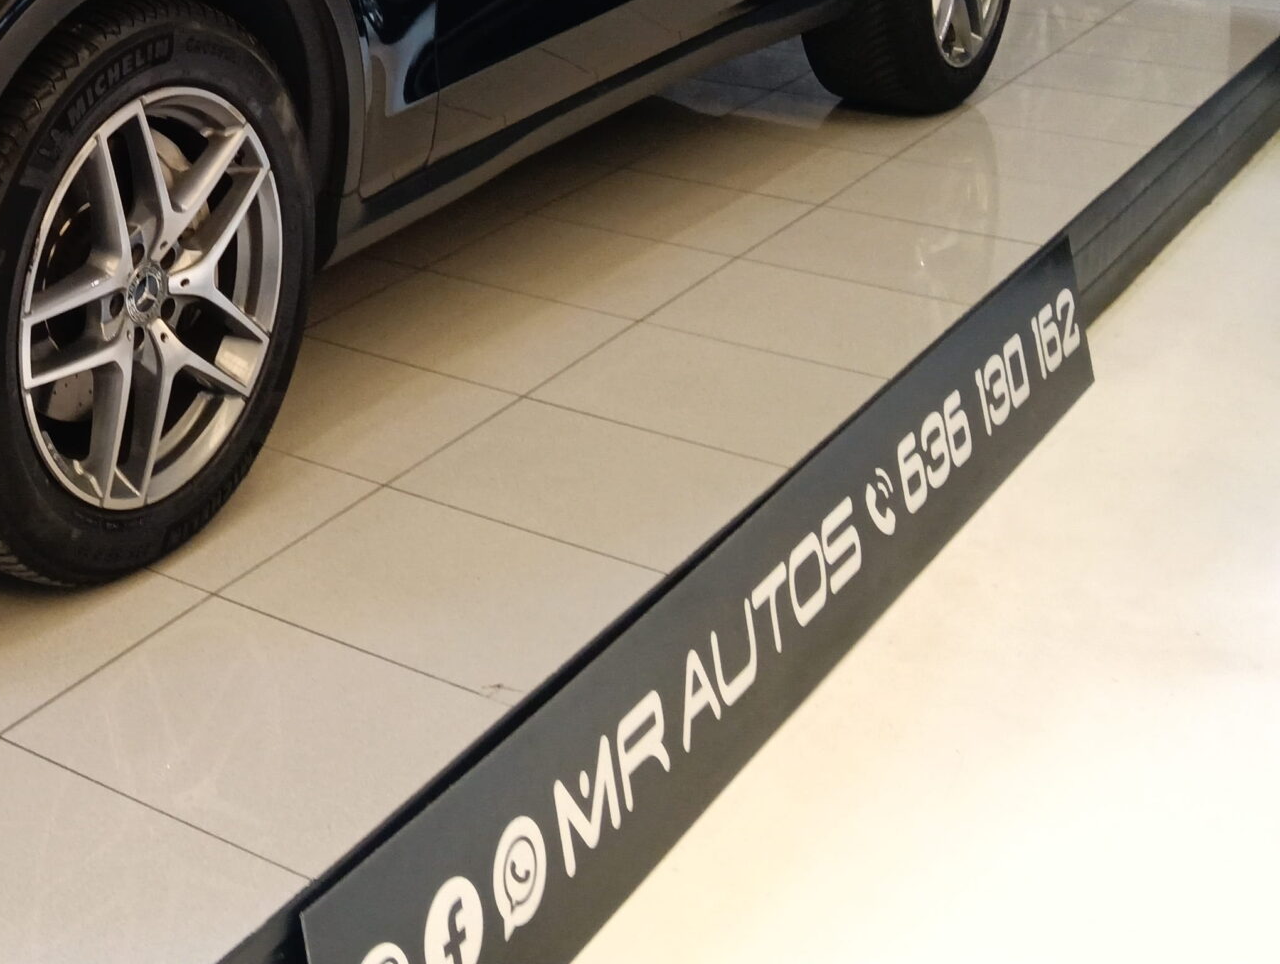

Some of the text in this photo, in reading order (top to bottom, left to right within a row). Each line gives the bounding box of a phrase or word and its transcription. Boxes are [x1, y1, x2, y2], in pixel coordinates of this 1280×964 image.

[66, 37, 170, 127] MICHELIN
[553, 288, 1081, 878] MR AUTOS 636 130 162
